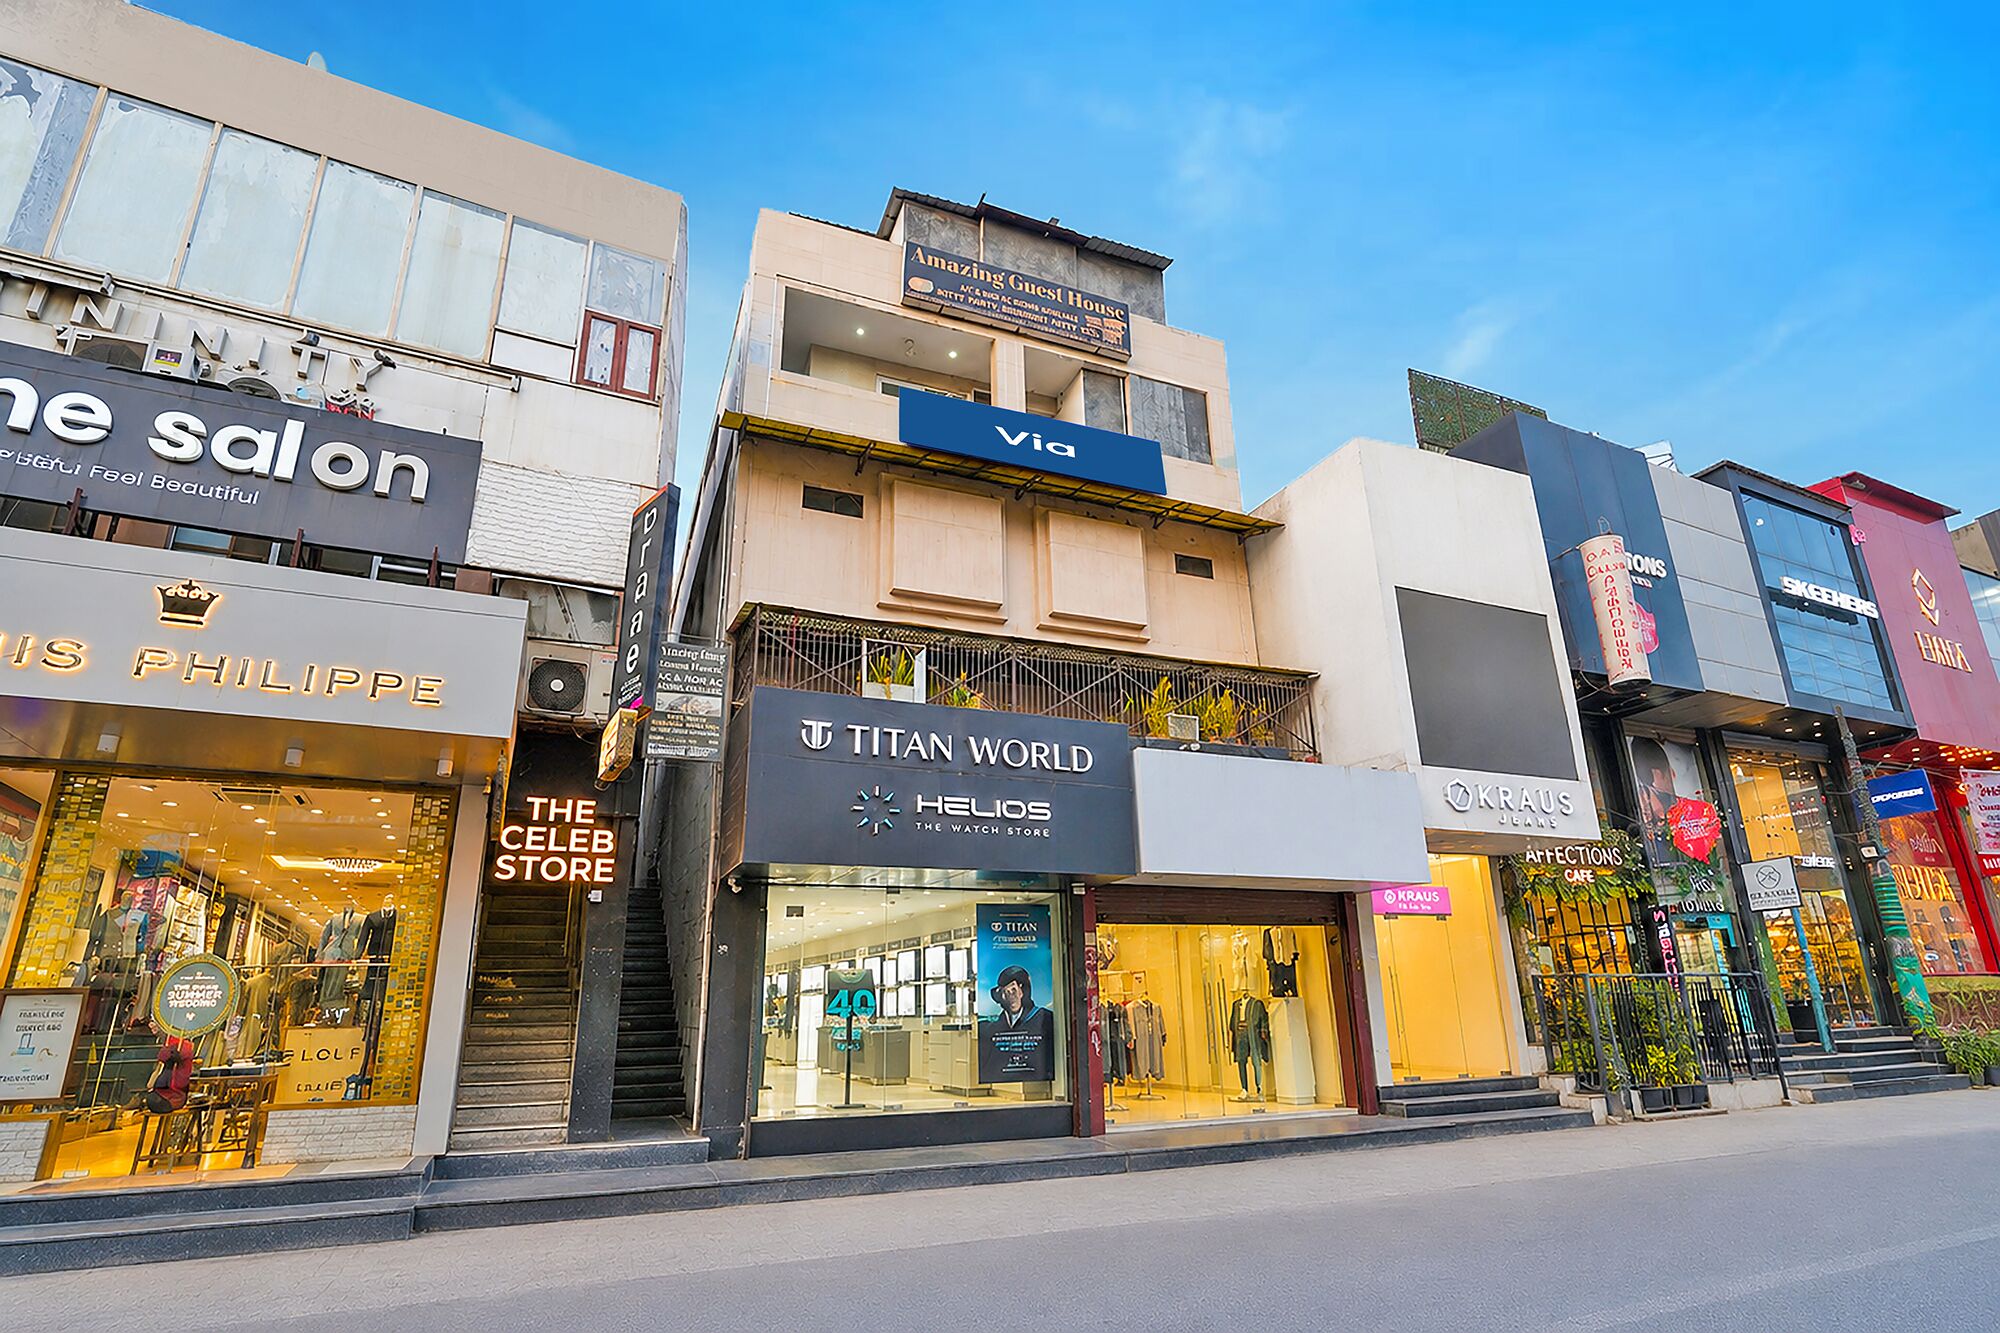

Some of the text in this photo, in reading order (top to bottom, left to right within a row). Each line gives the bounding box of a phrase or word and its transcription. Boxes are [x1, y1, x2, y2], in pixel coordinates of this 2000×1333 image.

[911, 246, 1006, 290] Amazing
[1008, 273, 1063, 303] Guest
[1068, 290, 1126, 321] House
[148, 409, 429, 503] salon
[994, 425, 1076, 458] Via
[89, 464, 260, 505] Feel Beautiful
[0, 634, 445, 706] IS PHILIPPE
[846, 723, 1095, 773] TITAN WORLD
[526, 796, 596, 824] THE
[916, 793, 1052, 821] HELIOS
[1478, 784, 1574, 815] KRAUS
[500, 825, 614, 854] CELEB
[915, 821, 1050, 837] THE WATCH STORE
[494, 854, 615, 883] STORE
[1564, 868, 1595, 883] CAFE
[1397, 890, 1440, 902] KRAUS
[1005, 922, 1037, 932] TITAN
[826, 988, 876, 1019] 40
